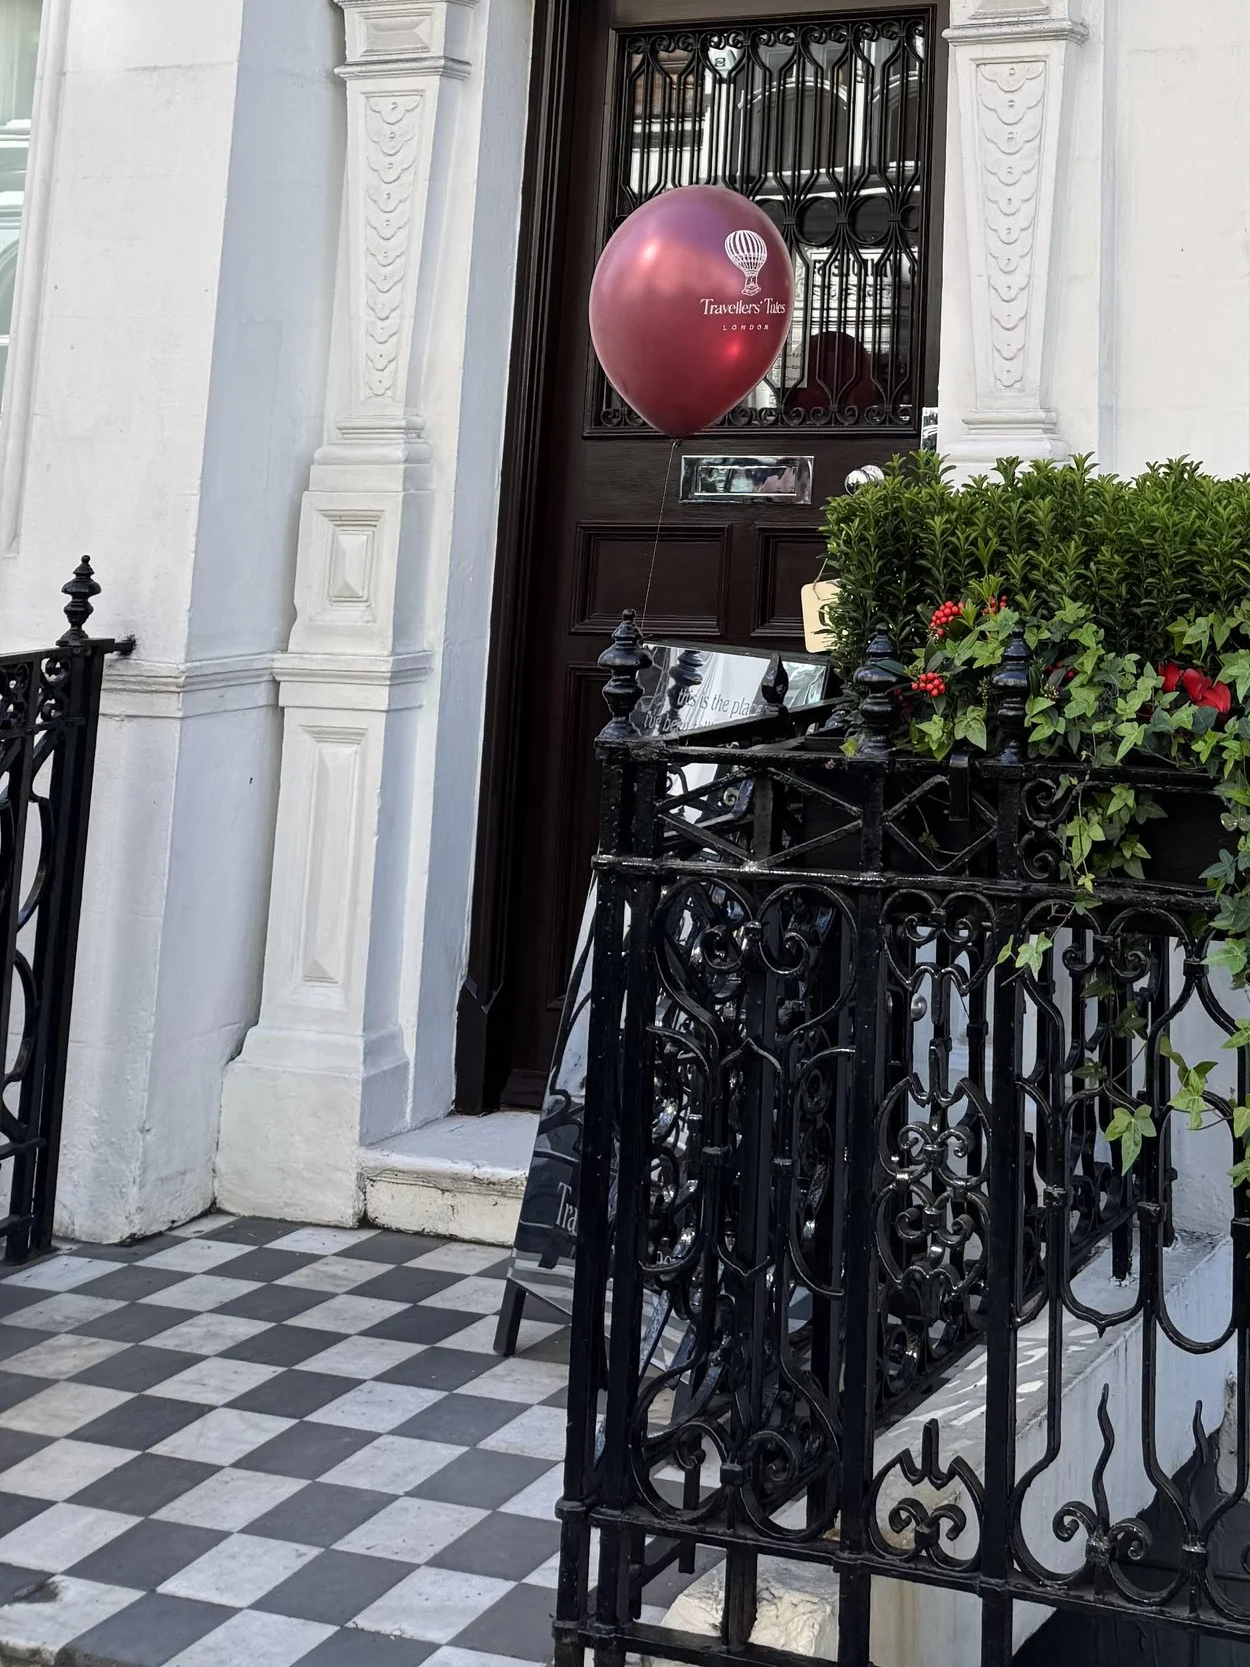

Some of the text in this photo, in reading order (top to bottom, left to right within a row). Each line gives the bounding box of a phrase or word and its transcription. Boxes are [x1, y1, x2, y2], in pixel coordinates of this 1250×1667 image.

[700, 297, 786, 315] Travellers' Tales
[677, 687, 697, 708] this
[711, 694, 730, 713] the
